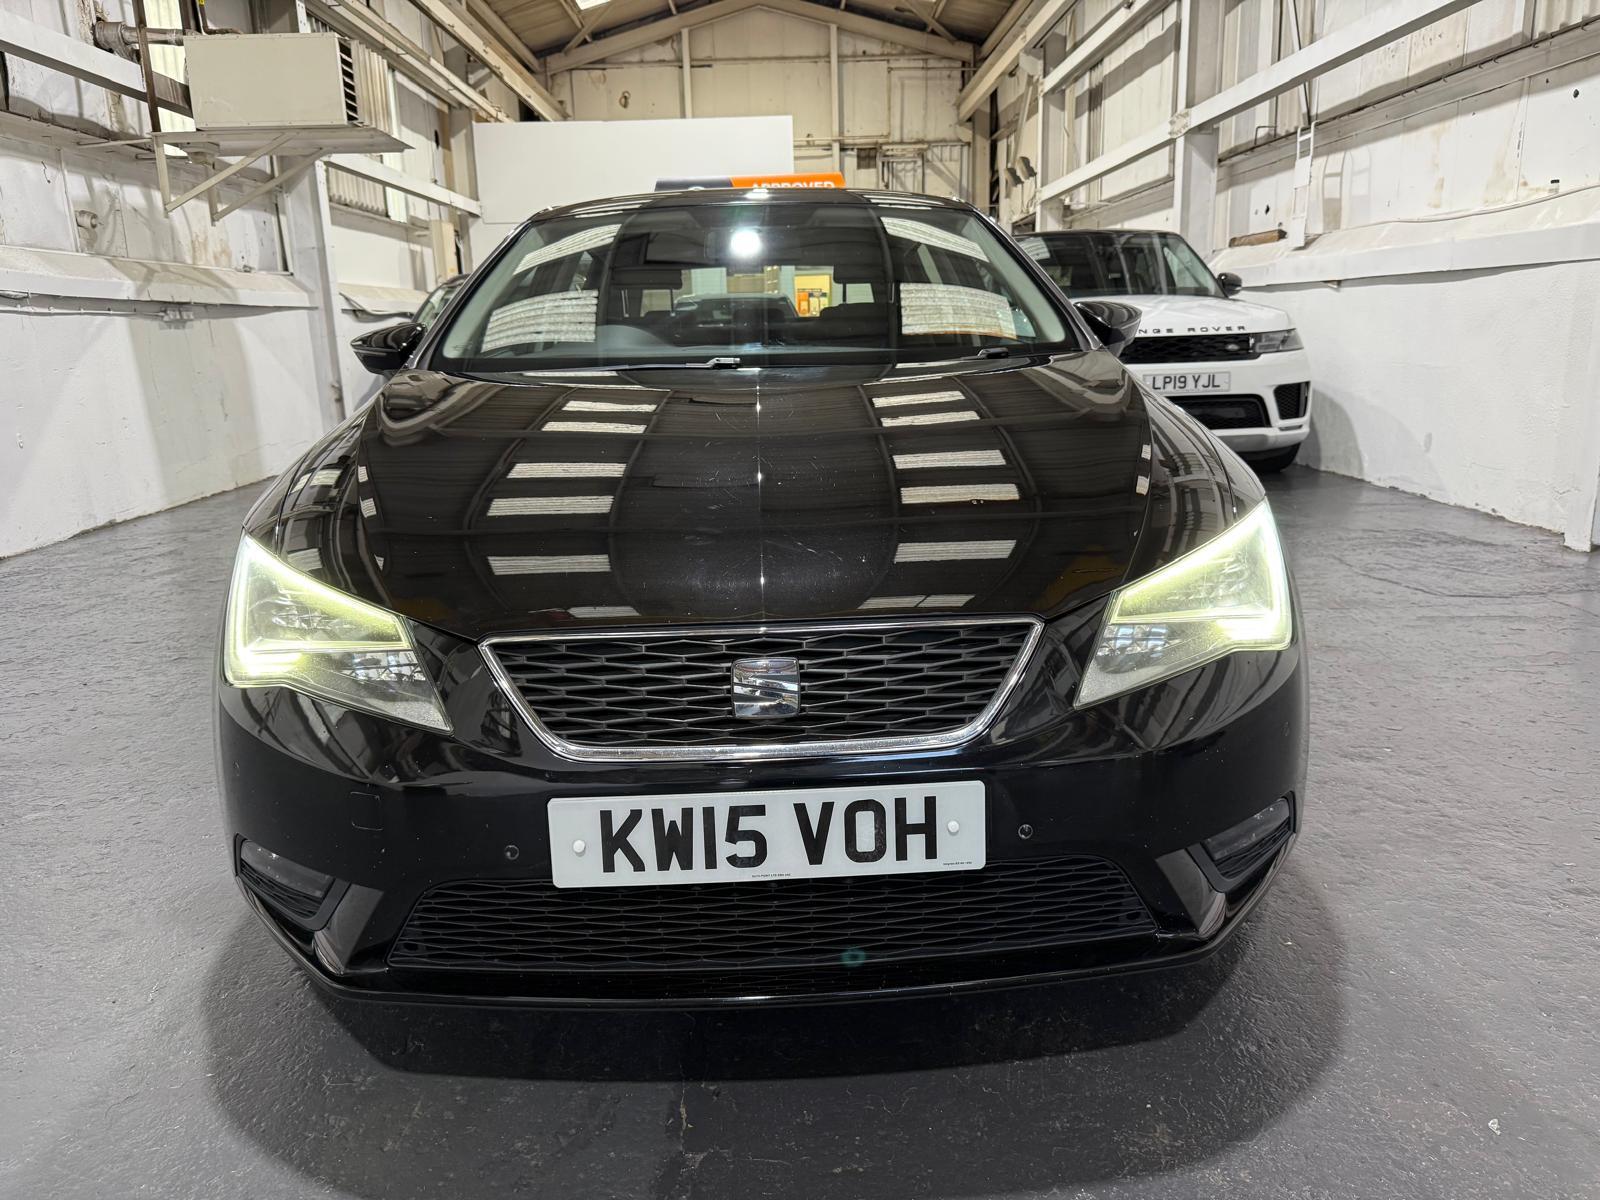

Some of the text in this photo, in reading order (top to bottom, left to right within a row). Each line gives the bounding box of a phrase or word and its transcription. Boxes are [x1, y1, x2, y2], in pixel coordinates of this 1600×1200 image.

[1152, 374, 1221, 390] LP19 YJL
[599, 795, 938, 873] KW15 VOH
